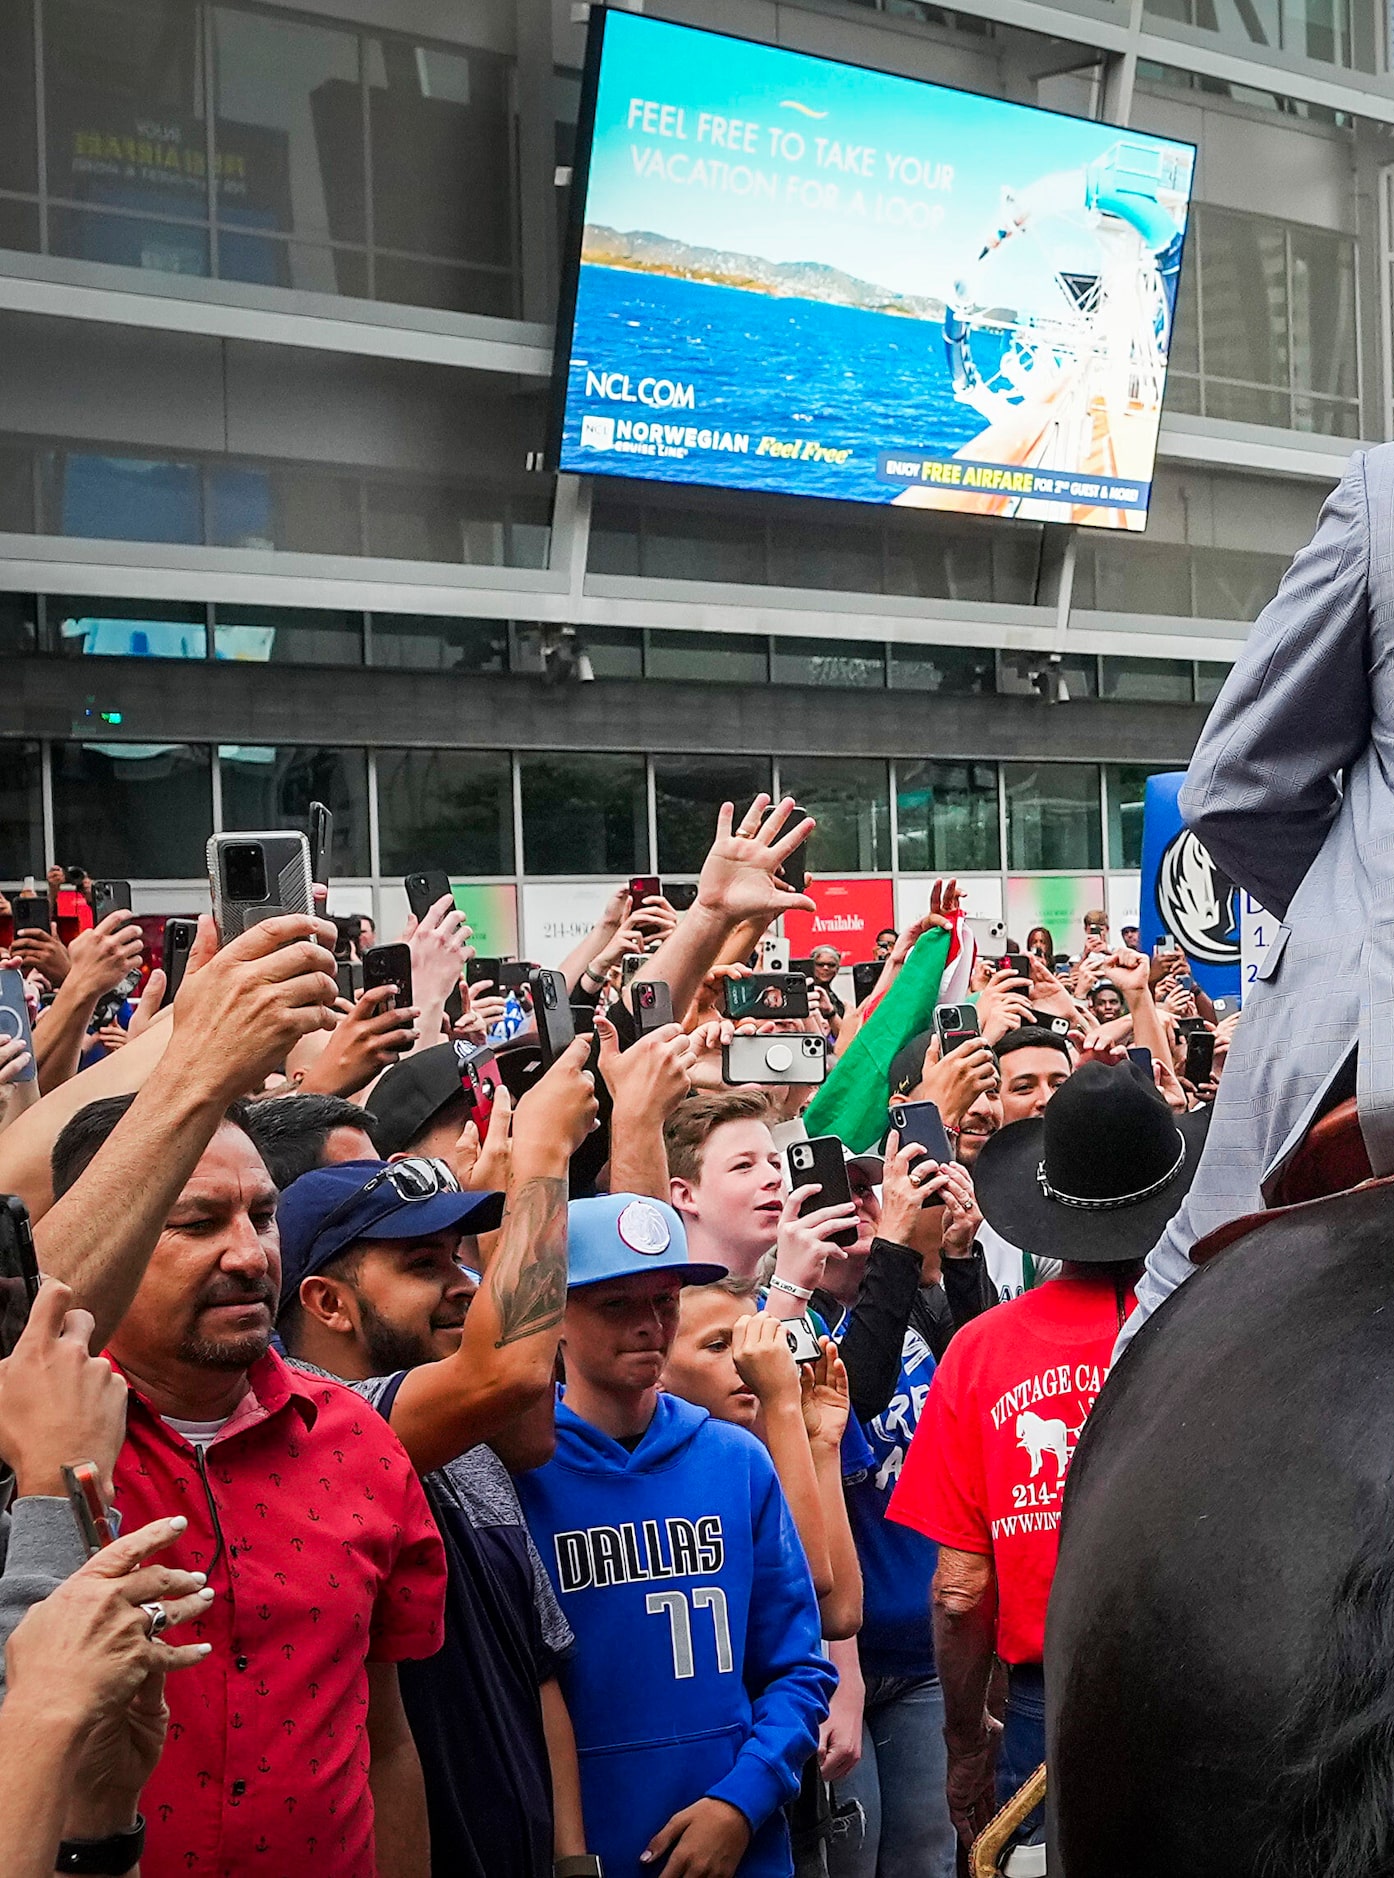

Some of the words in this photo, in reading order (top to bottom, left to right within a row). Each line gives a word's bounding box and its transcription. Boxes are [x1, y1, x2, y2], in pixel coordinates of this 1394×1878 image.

[628, 98, 687, 140] FEEL
[697, 112, 760, 154] FREE
[768, 127, 805, 162] TO
[814, 137, 876, 177] TAKE
[885, 151, 954, 192] YOUR
[630, 144, 778, 198] VACATION
[785, 174, 840, 210] FOR
[844, 190, 867, 217] A
[875, 193, 945, 232] LOOP
[613, 440, 656, 457] CRUISE
[616, 419, 749, 454] NORWEGIAN
[755, 435, 800, 459] Feel
[886, 460, 921, 477] ENJOY
[921, 461, 962, 485] FREE
[962, 466, 1034, 494] AIRFARE
[1034, 477, 1054, 493] FOR
[1070, 481, 1101, 498] GUEST
[1101, 485, 1108, 499] &
[811, 914, 865, 933] Available
[990, 1364, 1073, 1431] VINTAGE
[554, 1515, 725, 1593] DALLAS
[645, 1586, 733, 1680] 77
